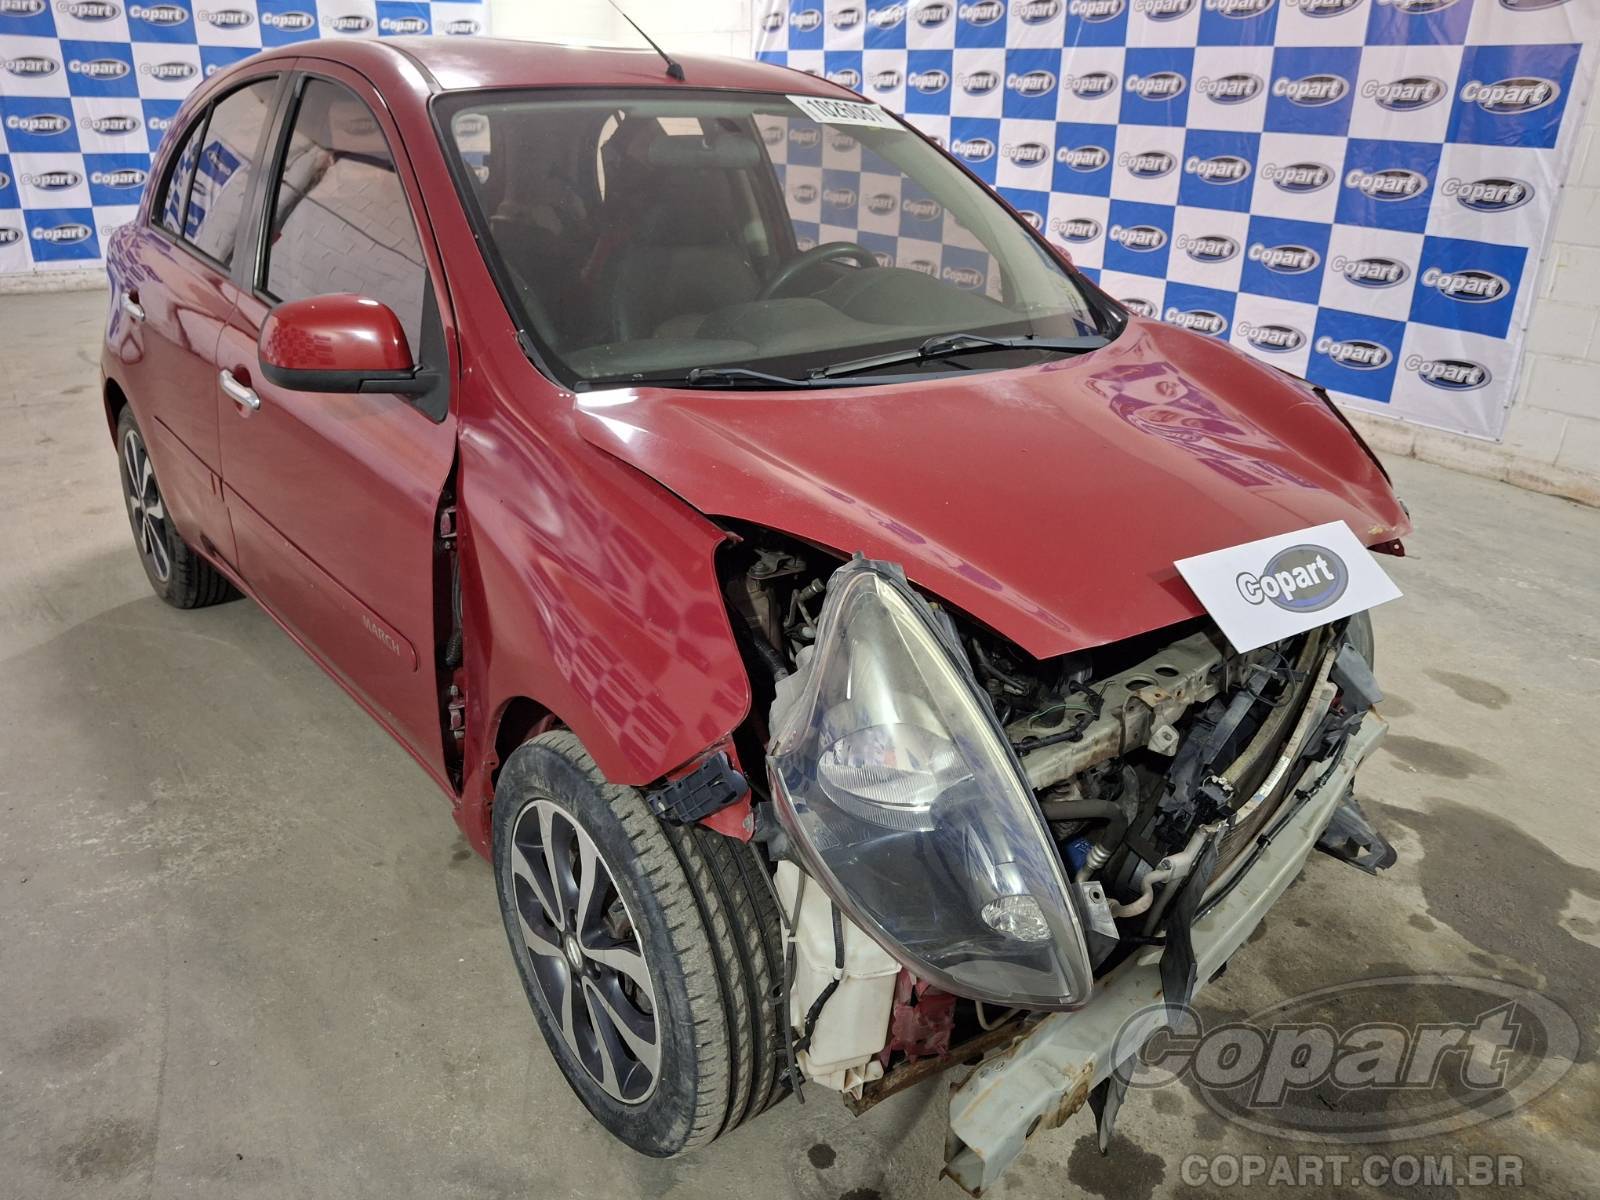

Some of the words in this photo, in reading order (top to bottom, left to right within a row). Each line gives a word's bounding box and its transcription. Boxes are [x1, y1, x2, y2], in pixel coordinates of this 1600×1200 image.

[0, 0, 38, 12] part
[57, 1, 113, 17] Copart
[129, 5, 181, 21] Copart
[958, 3, 999, 20] Copart
[1011, 1, 1056, 19] Copart
[1068, 0, 1120, 16] Copart
[1134, 0, 1187, 14] Copart
[1205, 0, 1265, 13] Copart
[199, 10, 245, 24] Copart
[261, 12, 308, 27] Copart
[381, 18, 422, 32] Copart
[68, 60, 121, 76] Copart
[140, 64, 190, 78] Copart
[1006, 73, 1050, 92] Copart
[1063, 74, 1111, 94] Copart
[1125, 74, 1179, 95] Copart
[1195, 76, 1254, 97] Copart
[1272, 77, 1339, 99] Copart
[1361, 80, 1435, 104] Copart
[1459, 80, 1550, 107] Copart
[6, 115, 64, 131] Copart
[80, 117, 133, 132] Copart
[951, 138, 991, 157] Copart
[1002, 144, 1044, 163] Copart
[1056, 146, 1103, 166] Copart
[1118, 152, 1171, 174] Copart
[1184, 155, 1244, 179] Copart
[20, 173, 75, 188] Copart
[90, 172, 142, 186] Copart
[1262, 163, 1326, 187] Copart
[1344, 169, 1417, 195] Copart
[1441, 177, 1523, 203] Copart
[31, 227, 85, 242] Copart
[1050, 217, 1097, 237] Copart
[1109, 223, 1161, 246] Copart
[1176, 234, 1234, 256] Copart
[1247, 242, 1313, 268] Copart
[1331, 255, 1400, 282] Copart
[1420, 266, 1501, 296] Copart
[1165, 307, 1223, 331] Copart
[1237, 321, 1300, 347] Copart
[1315, 335, 1383, 365] Copart
[1404, 354, 1483, 385] Copart
[1236, 554, 1335, 605] Copart
